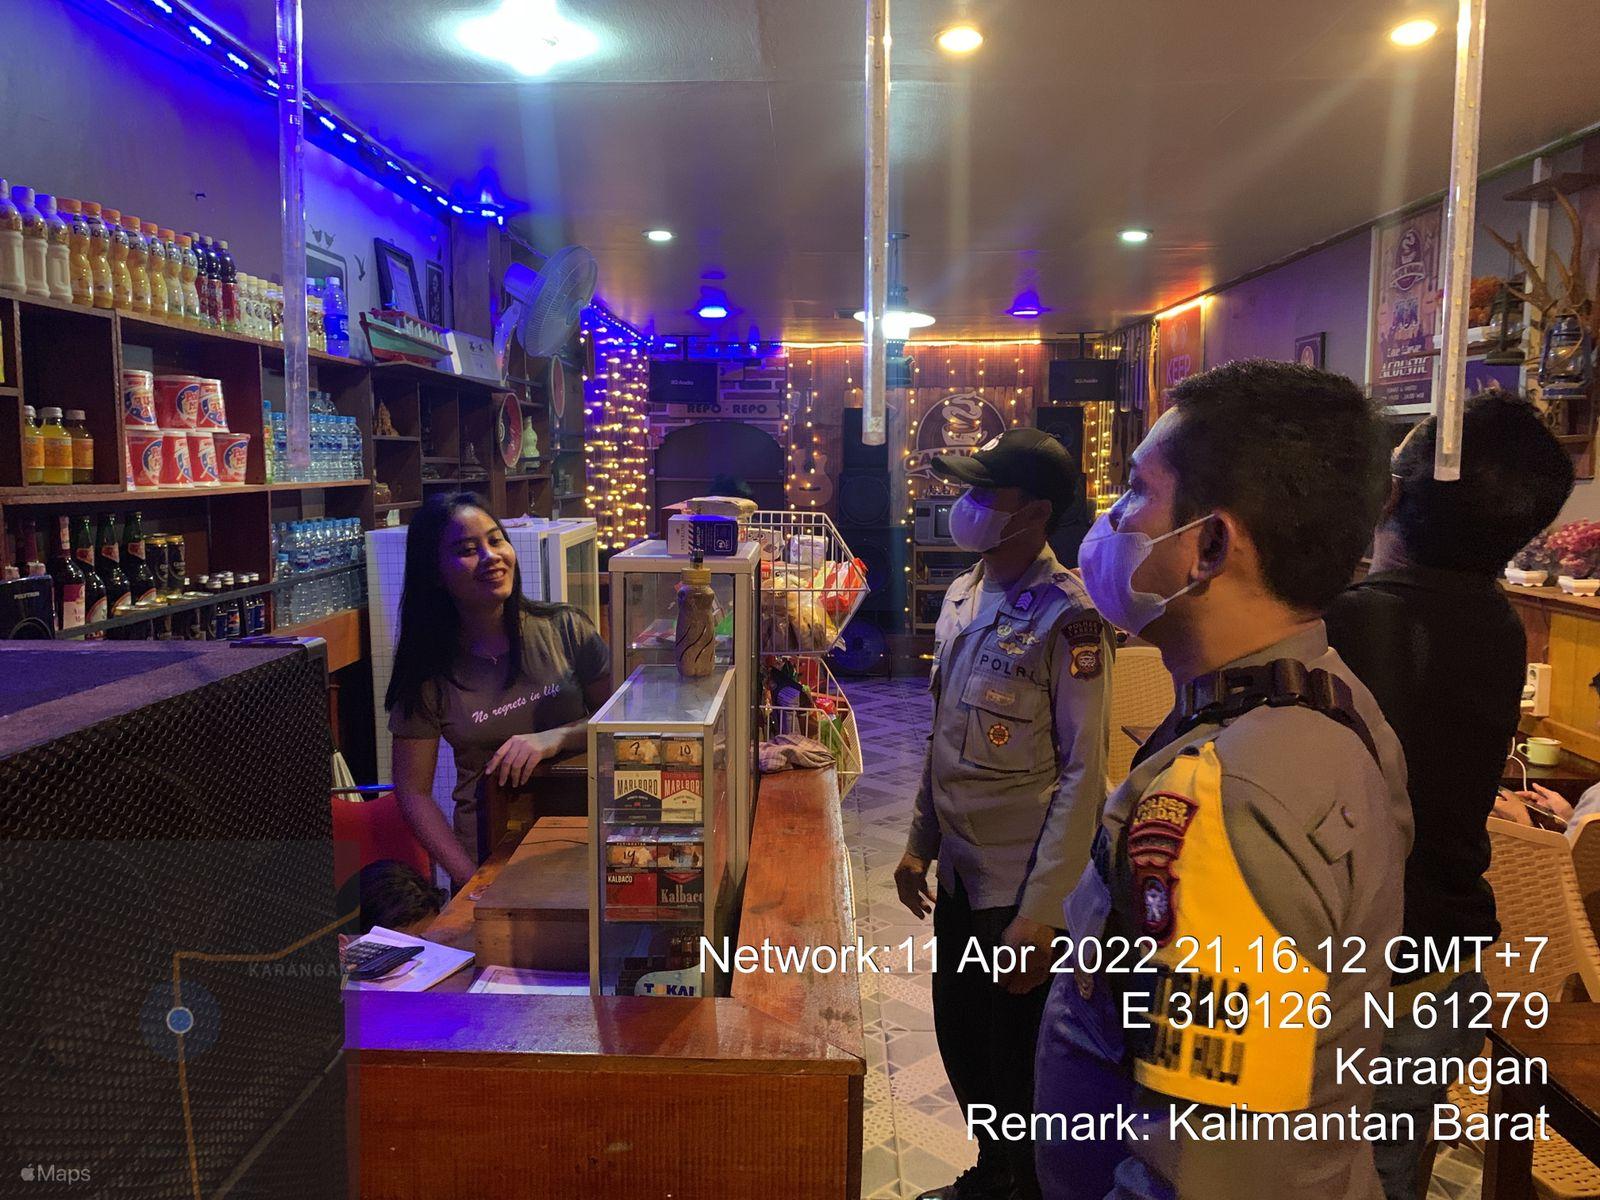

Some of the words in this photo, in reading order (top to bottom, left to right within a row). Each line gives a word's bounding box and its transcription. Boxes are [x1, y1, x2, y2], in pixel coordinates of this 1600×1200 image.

[687, 404, 722, 414] REPO
[732, 404, 768, 414] REPO
[471, 710, 489, 725] No
[491, 697, 527, 716] regrets
[530, 691, 541, 701] in
[543, 683, 561, 697] life
[680, 744, 692, 757] 10
[617, 779, 658, 797] MARLBORO
[664, 779, 704, 798] MARLBOR
